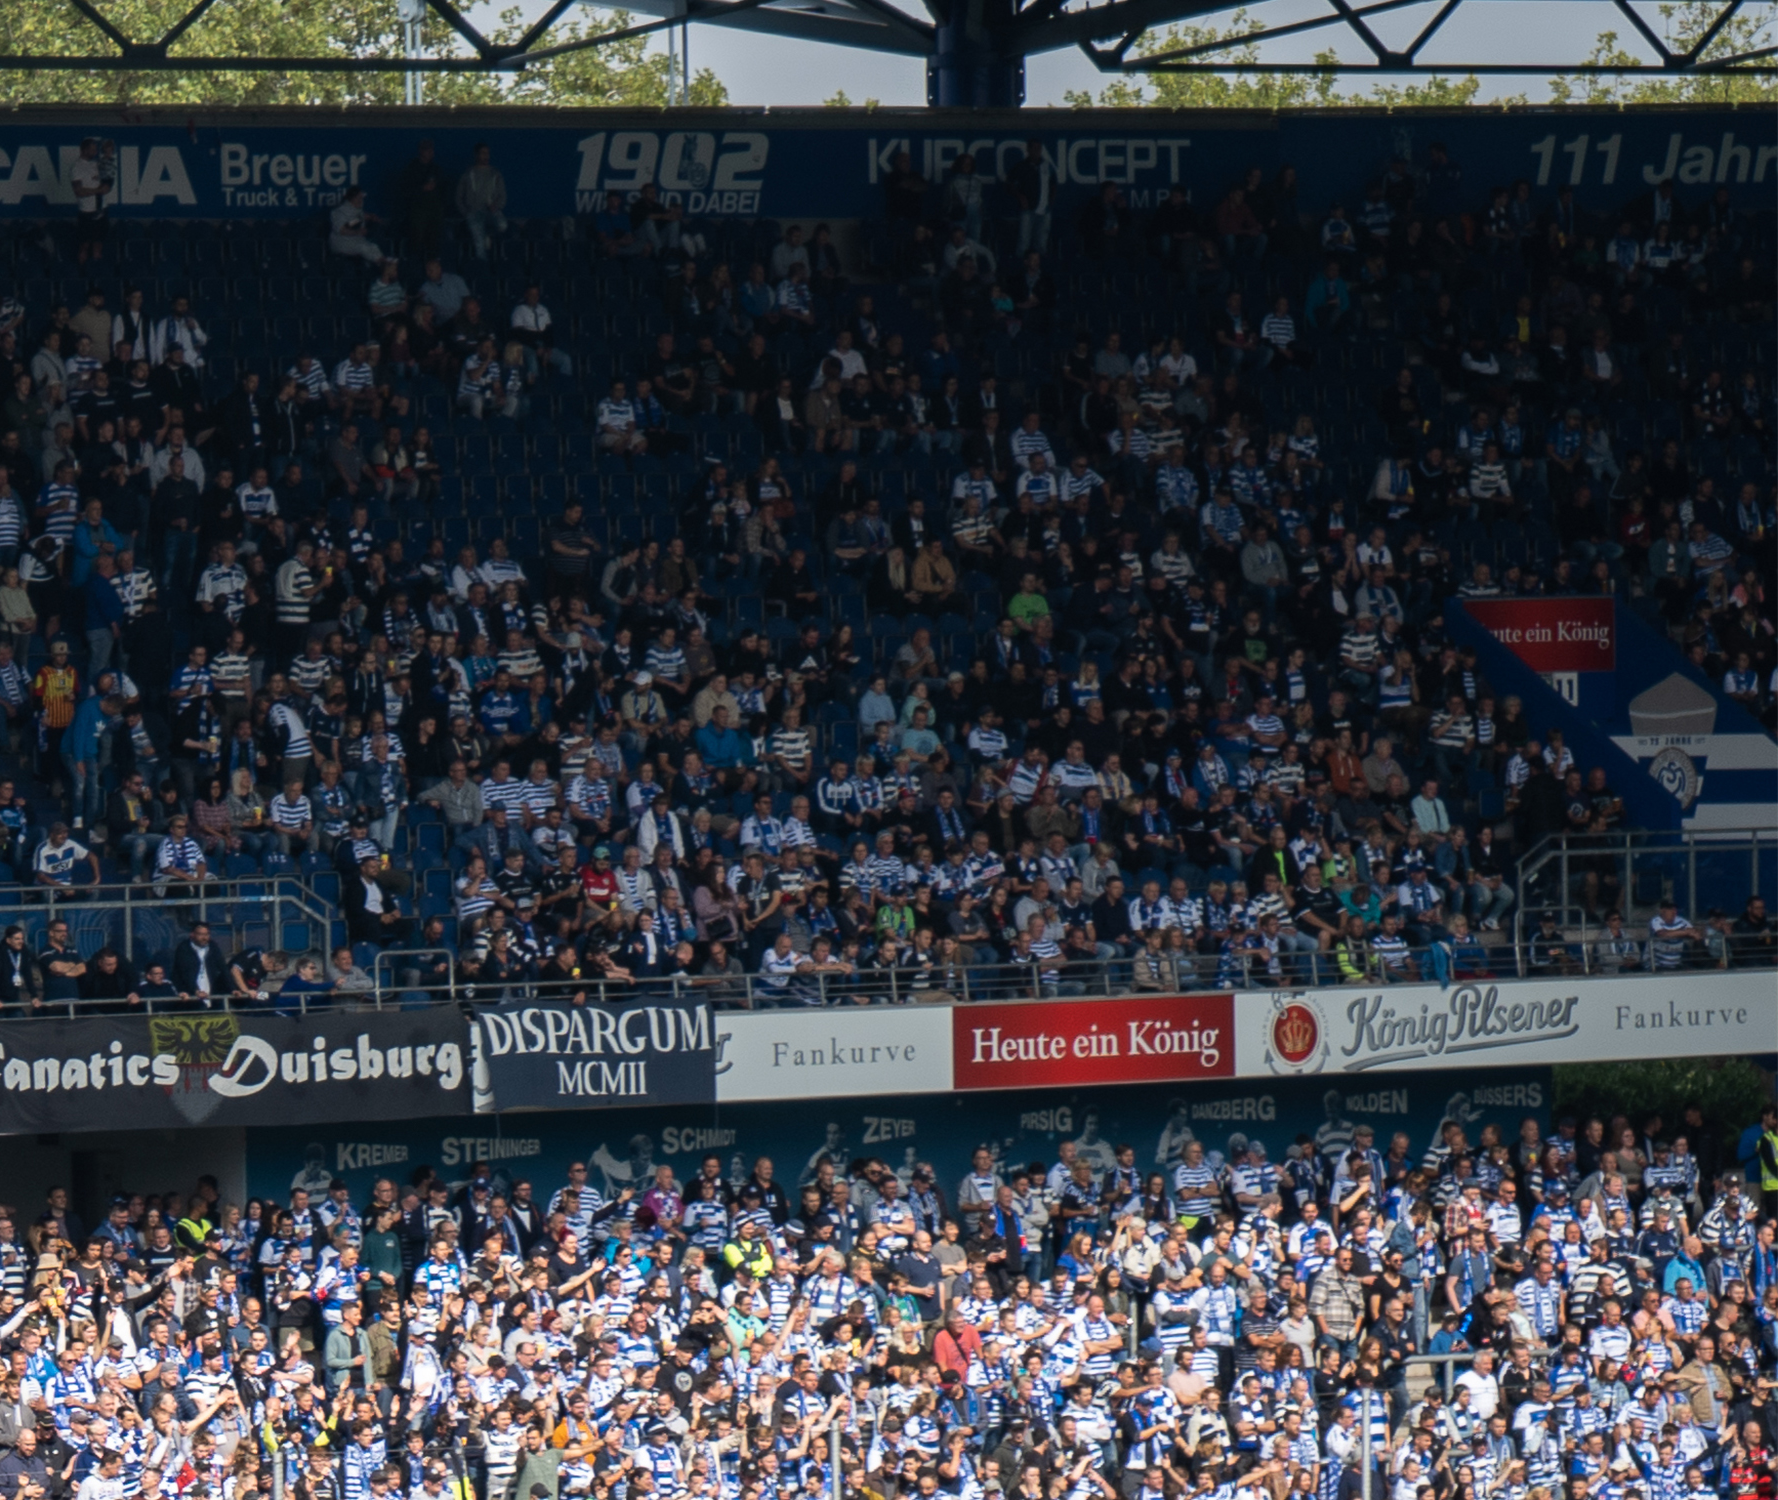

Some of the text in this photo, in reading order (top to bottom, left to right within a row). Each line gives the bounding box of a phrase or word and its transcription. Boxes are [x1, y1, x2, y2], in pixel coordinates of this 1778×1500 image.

[221, 142, 367, 186] Breuer
[575, 131, 771, 191] 1902
[1530, 133, 1623, 186] 111
[221, 187, 299, 207] Truck &
[687, 190, 762, 214] DABEI
[1525, 621, 1611, 650] ein König
[480, 1003, 713, 1056] DISPARGUM
[1340, 995, 1449, 1057] König
[1446, 983, 1580, 1044] Pilsener
[1614, 1003, 1748, 1031] Fankurve
[772, 1037, 917, 1068] Fankurve
[971, 1026, 1067, 1064] Heute
[1072, 1022, 1121, 1059] ein
[1127, 1018, 1221, 1069] König
[206, 1034, 463, 1098] Duisburg
[557, 1060, 648, 1096] MCMII
[1190, 1094, 1277, 1122] DANZBERG
[1345, 1087, 1409, 1116] NOLDEN
[1473, 1082, 1543, 1110] BÜSSERS
[862, 1116, 916, 1144] ZEYER
[1020, 1105, 1072, 1134] PIRSIG
[442, 1136, 541, 1167] STEININGER
[661, 1125, 737, 1155] SCHMIDT
[337, 1141, 409, 1170] KREMER
